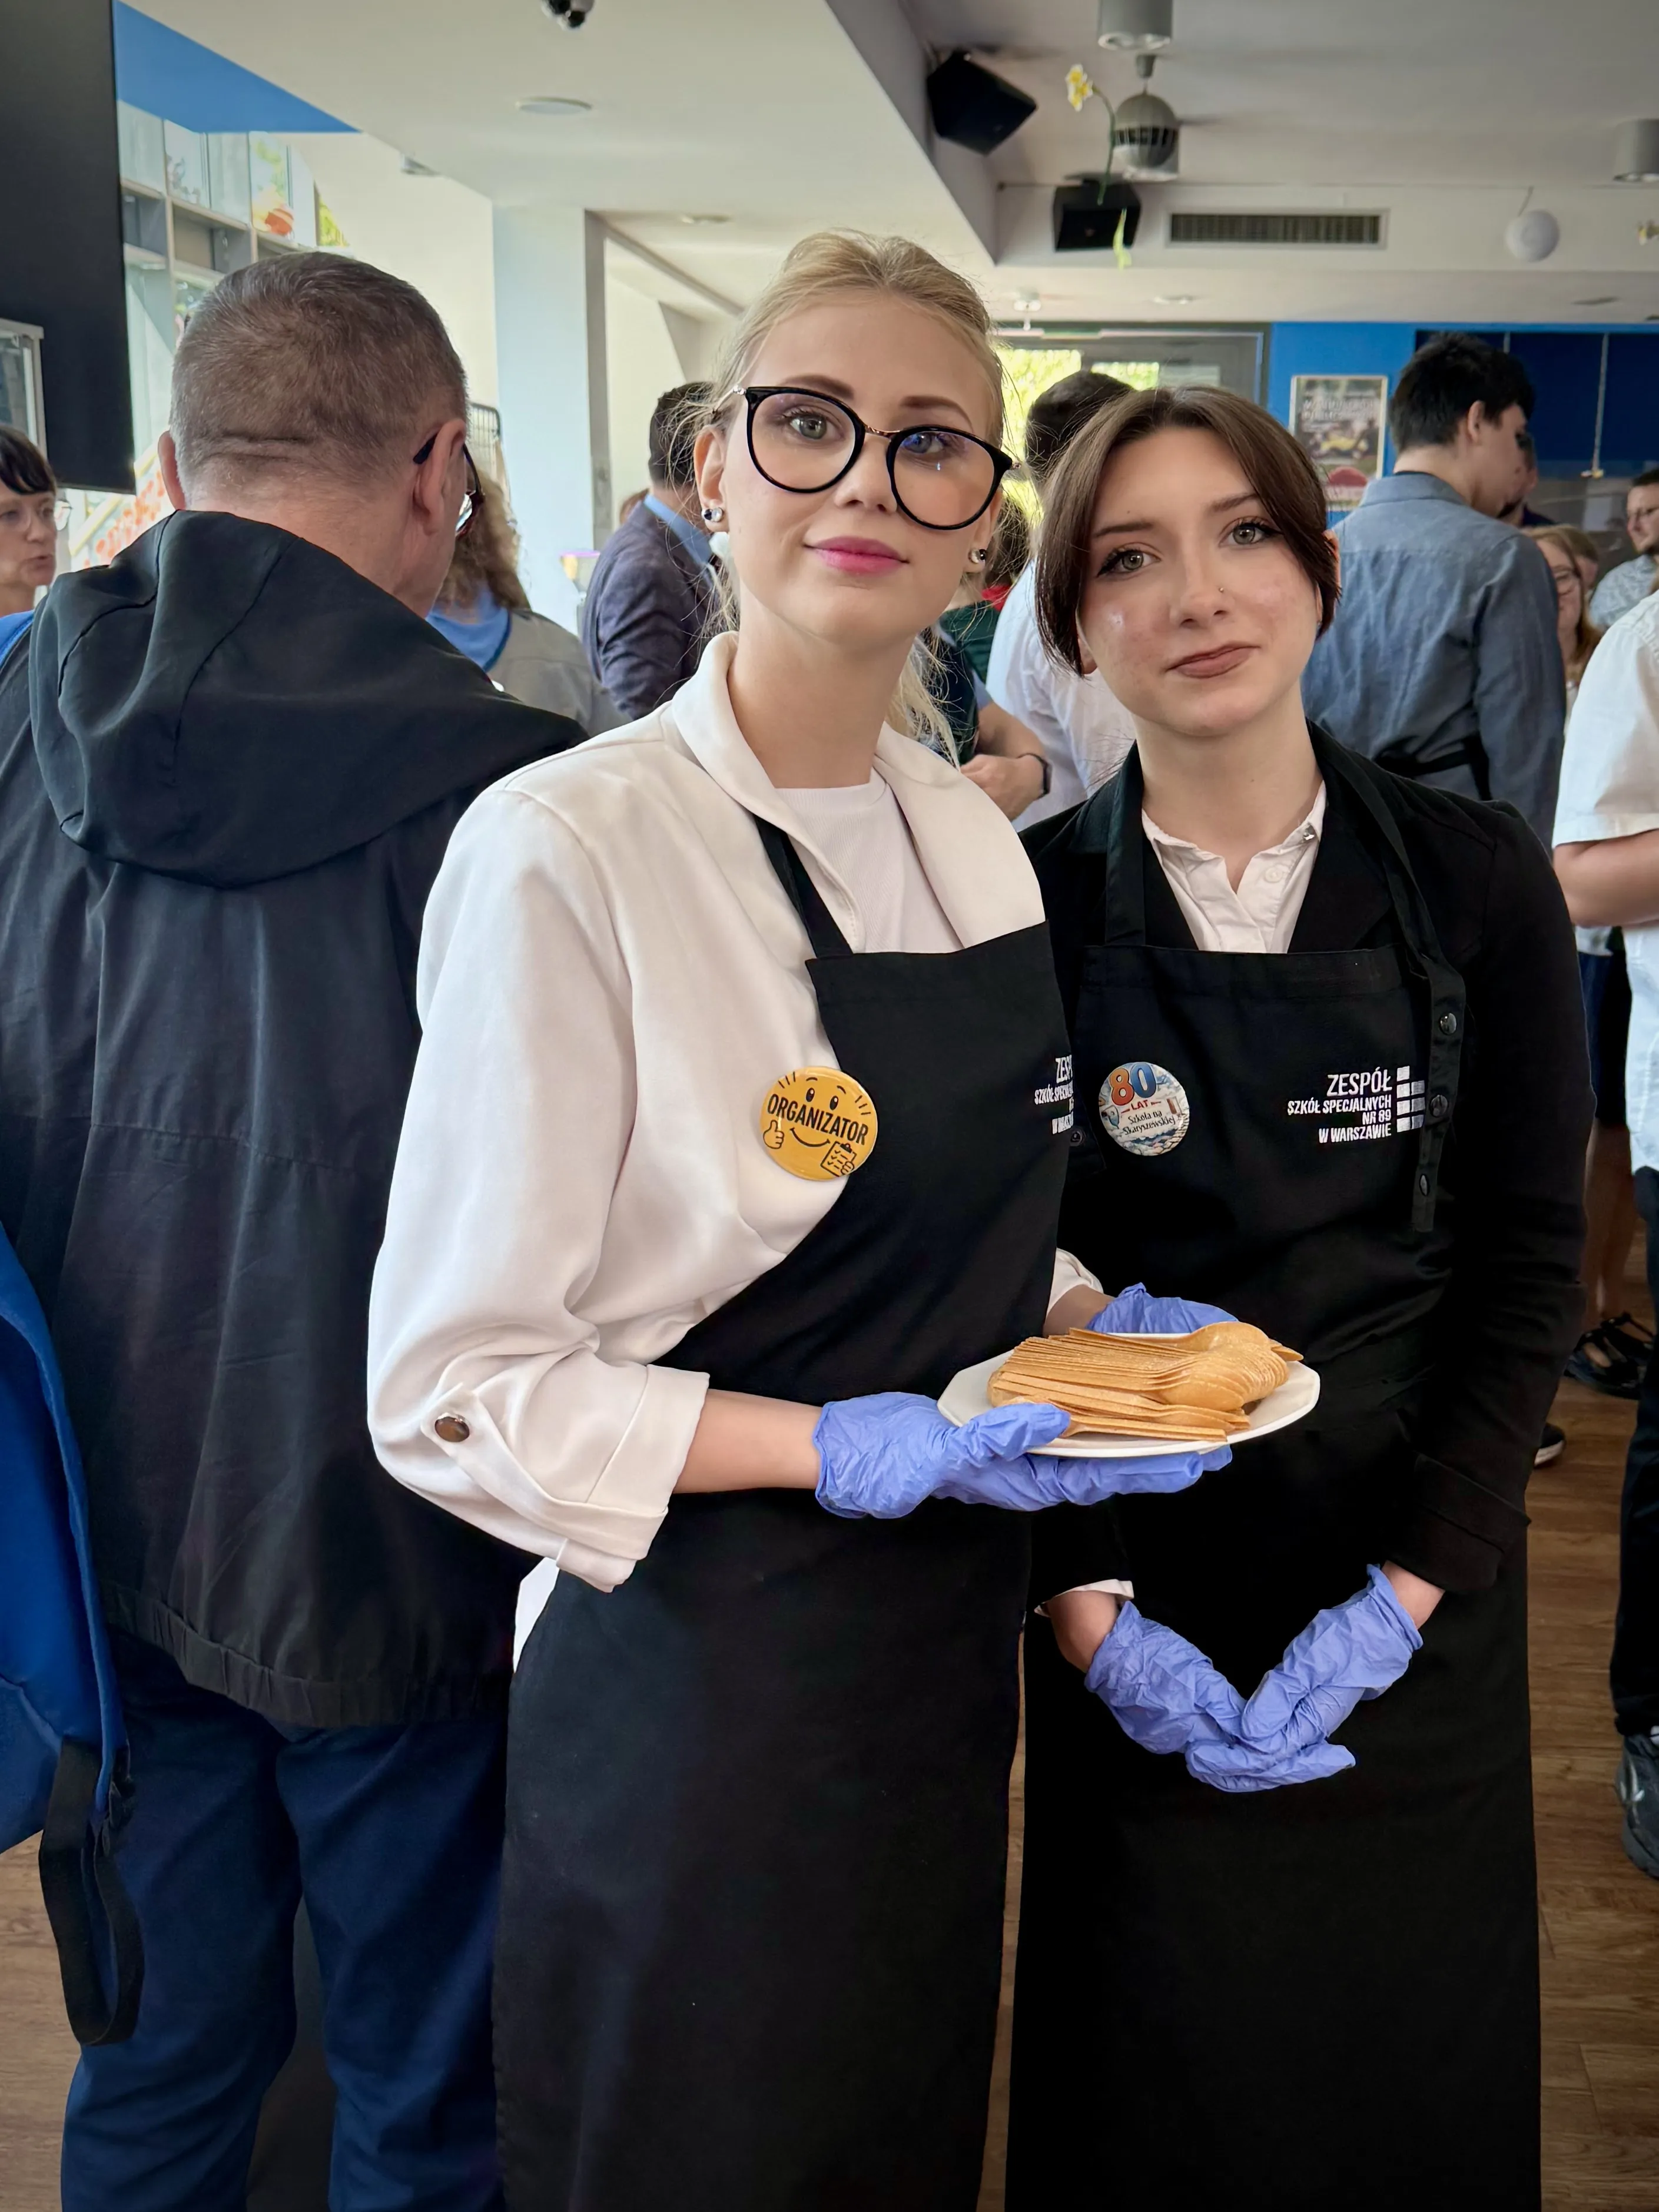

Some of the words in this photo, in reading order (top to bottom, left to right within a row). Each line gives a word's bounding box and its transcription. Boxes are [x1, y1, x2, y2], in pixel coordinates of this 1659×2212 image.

[1109, 1062, 1157, 1106] 80
[1326, 1067, 1392, 1097] ZESPÓŁ
[1034, 1084, 1054, 1105] SZKÓŁ
[1131, 1100, 1148, 1110] LAT
[1287, 1097, 1320, 1116] SZKÓŁ
[1322, 1094, 1392, 1114] SPECJALNYCH
[767, 1093, 869, 1145] ORGANIZATOR
[1362, 1112, 1376, 1125] NR
[1378, 1109, 1392, 1123] 89
[1319, 1128, 1329, 1143] W
[1330, 1123, 1392, 1143] WARSZAWIE
